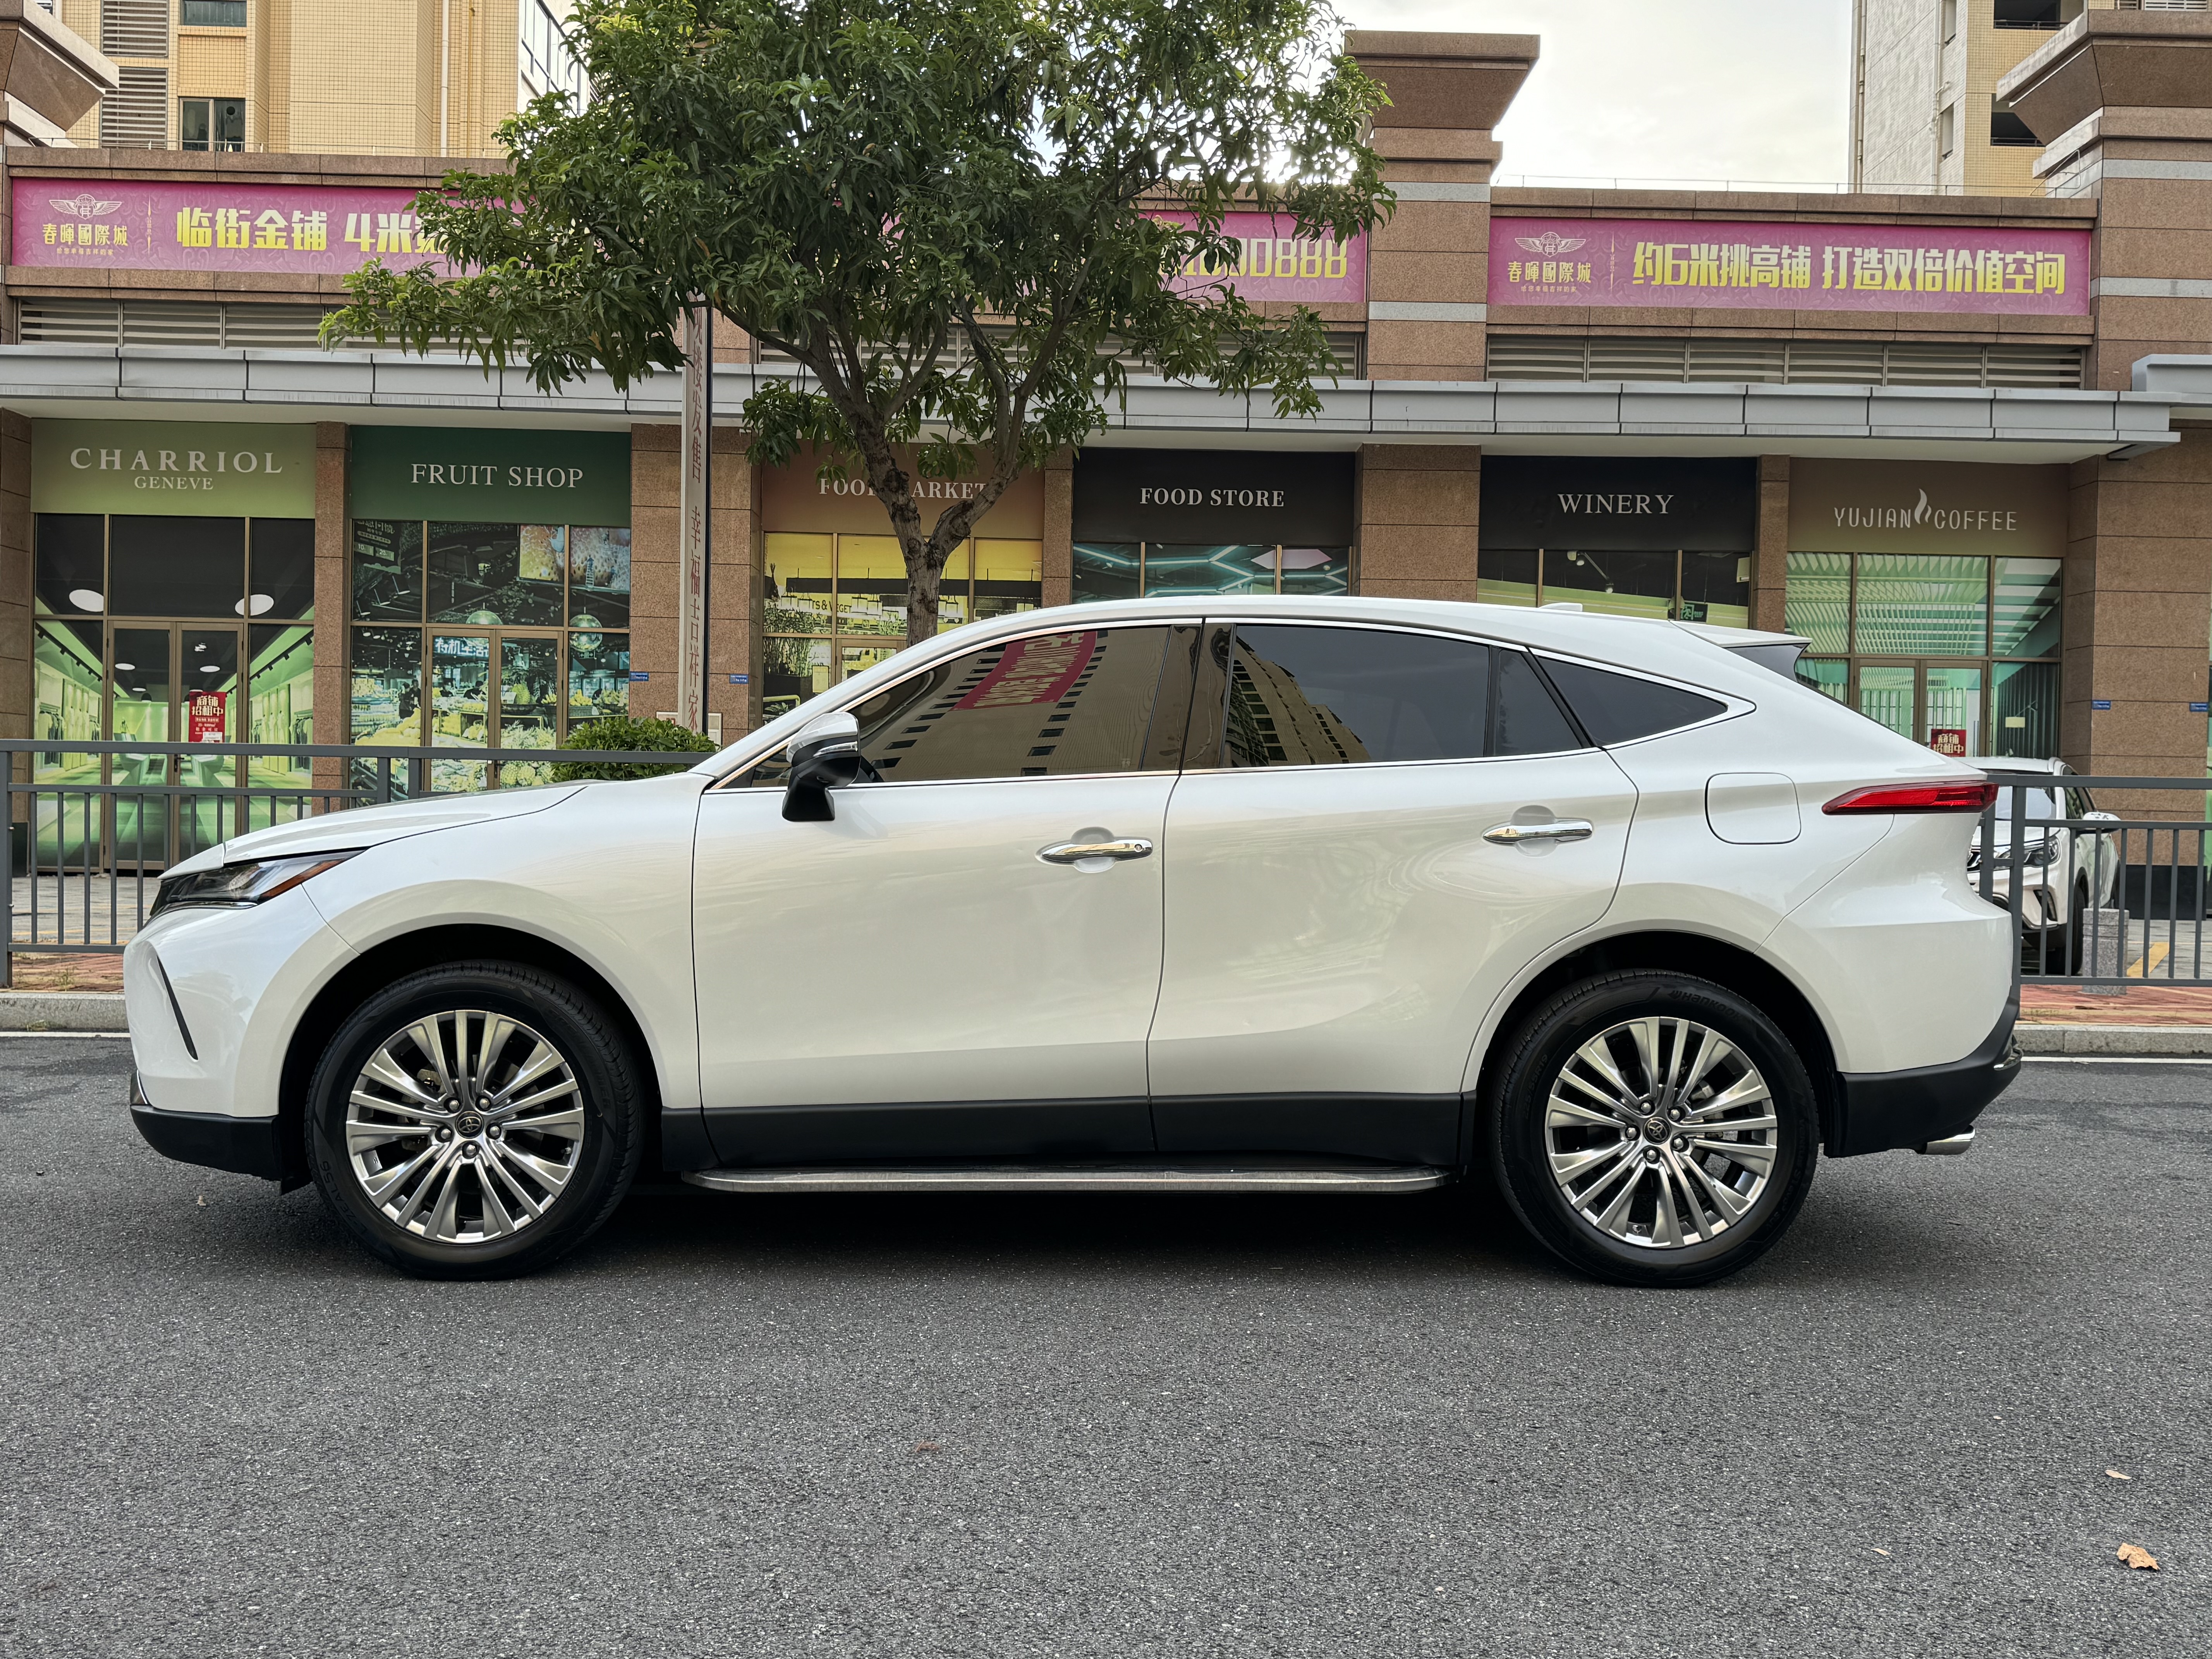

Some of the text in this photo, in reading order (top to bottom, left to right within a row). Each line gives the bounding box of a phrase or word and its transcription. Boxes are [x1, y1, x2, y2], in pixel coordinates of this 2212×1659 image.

[177, 208, 327, 251] 临街金铺
[1633, 242, 2065, 294] 约6米挑高铺 打造双倍价值空间
[70, 448, 283, 474] CHARRIOL
[134, 476, 214, 490] GENEVE
[410, 464, 584, 488] FRUIT SHOP
[1140, 488, 1284, 507] FOOD STORE
[1558, 494, 1674, 514] WINERY
[1834, 507, 2017, 531] YUJIAN COFFEE
[192, 706, 223, 716] 招租中
[197, 695, 218, 707] 商铺
[1938, 733, 1959, 745] 商铺
